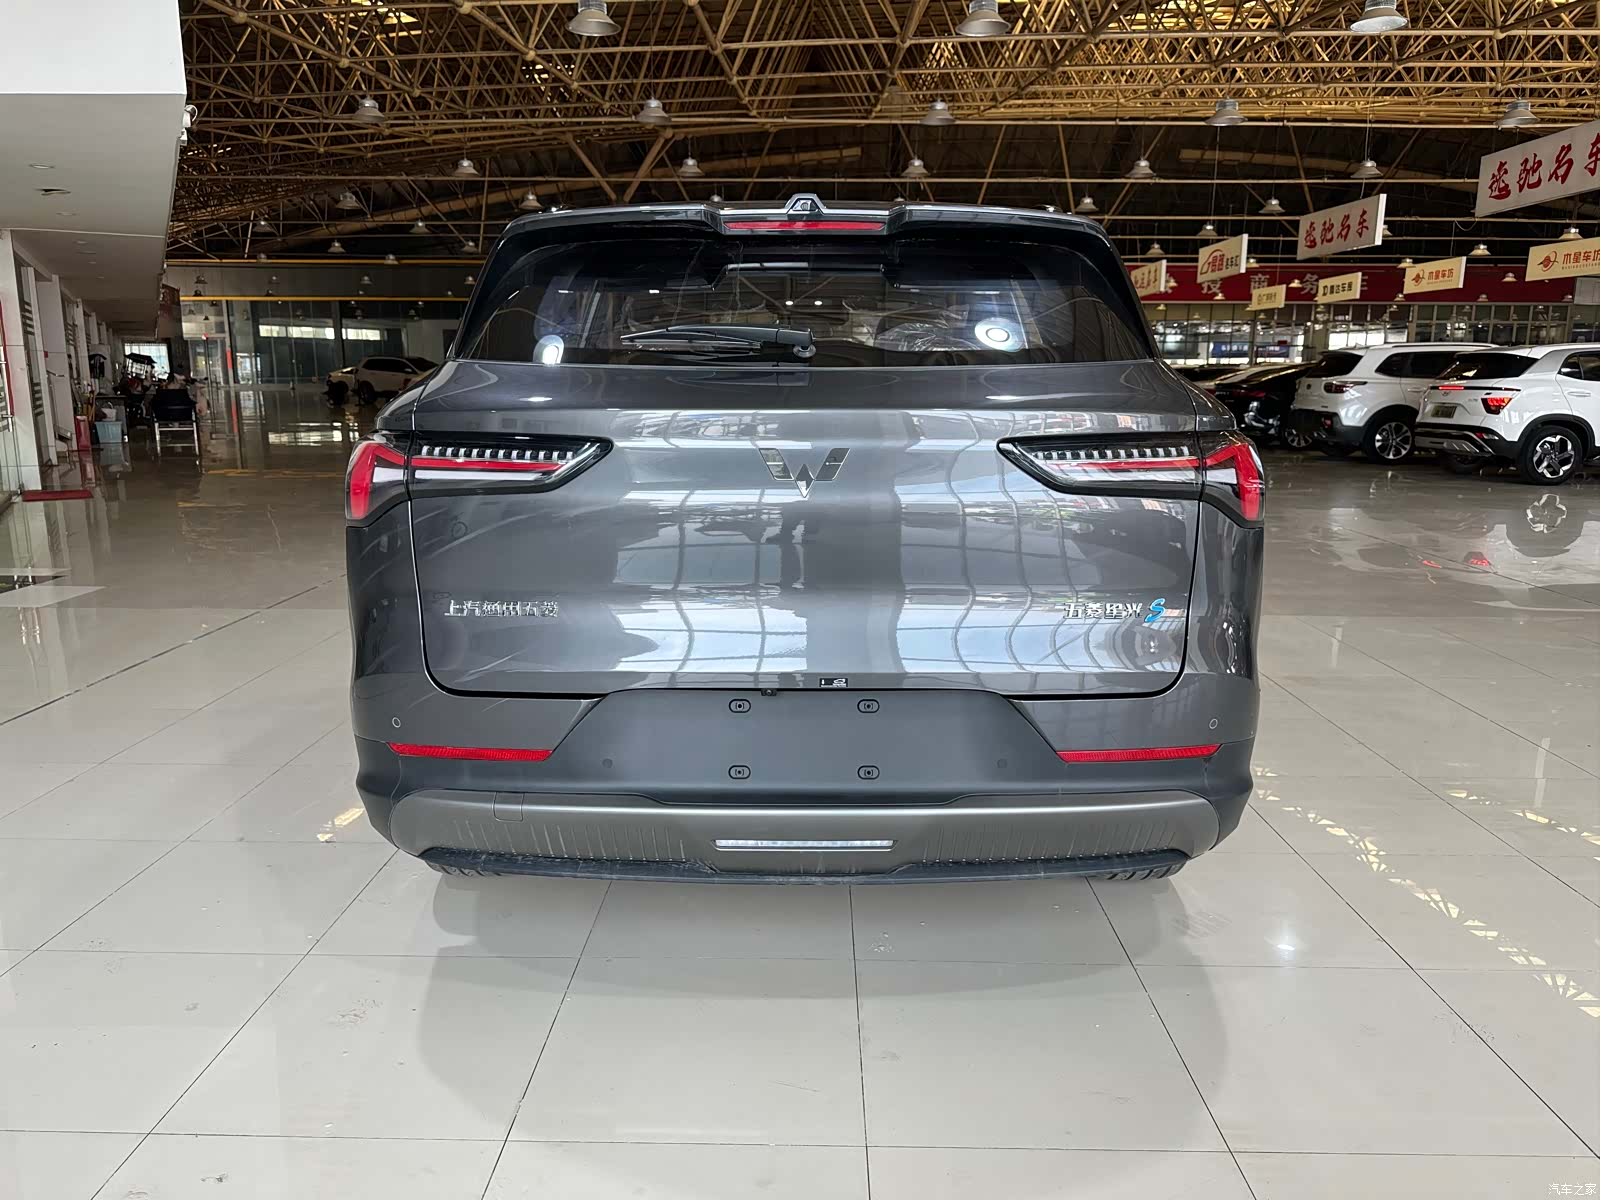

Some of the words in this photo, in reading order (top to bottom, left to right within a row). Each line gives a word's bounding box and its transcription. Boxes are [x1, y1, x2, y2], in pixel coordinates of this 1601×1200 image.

[444, 600, 559, 617] 上汽通用五菱
[1064, 602, 1143, 618] 五菱星光
[1144, 598, 1165, 623] S
